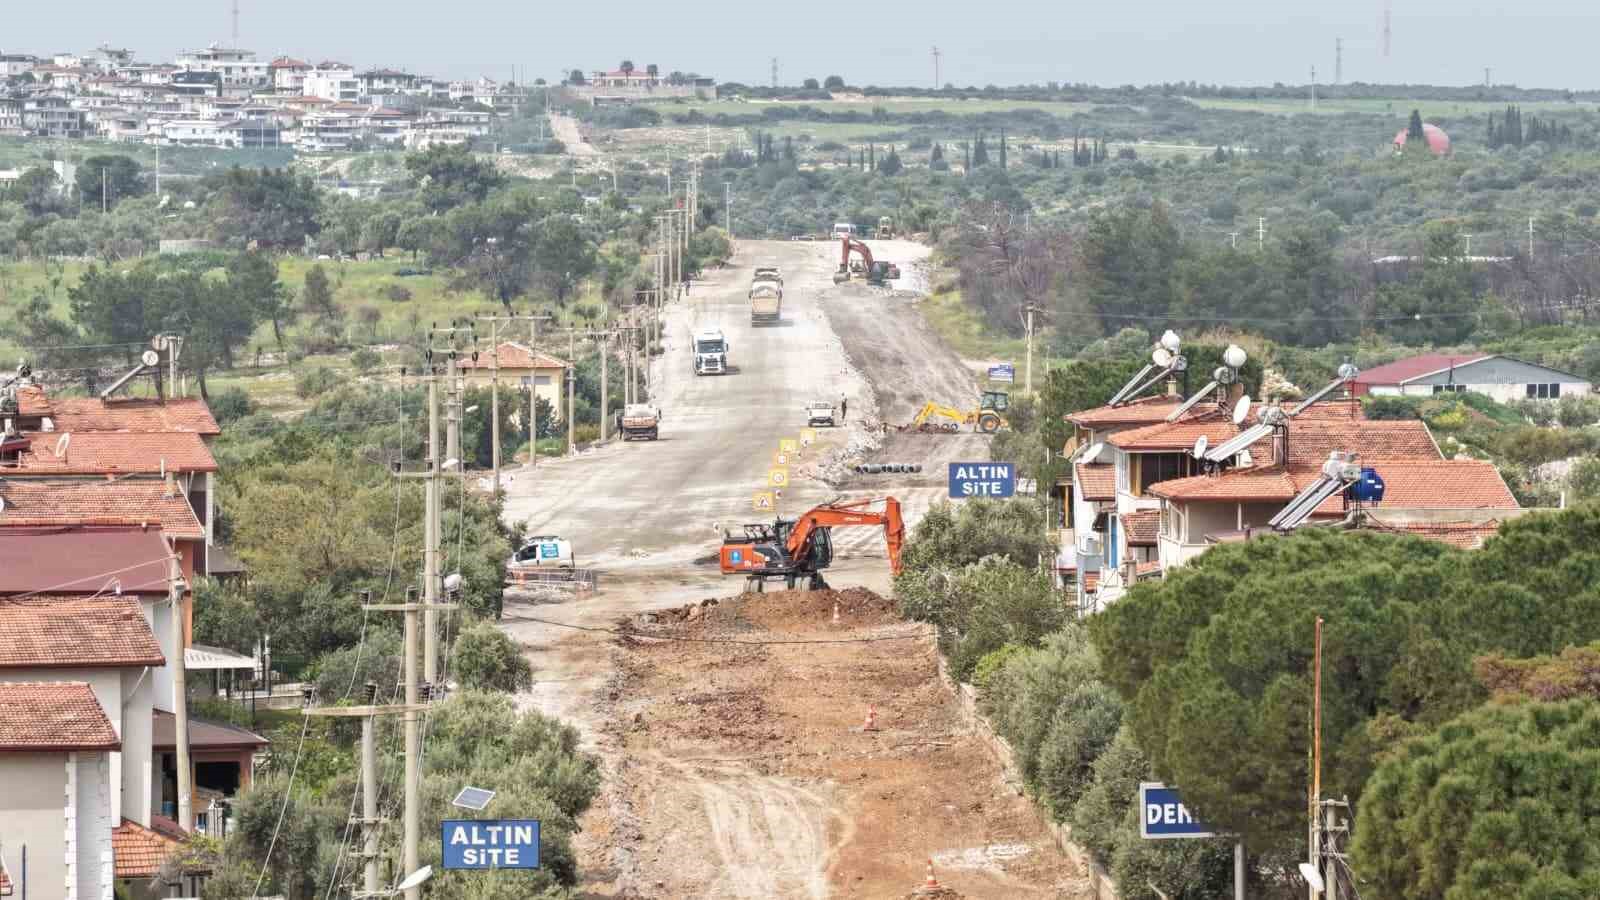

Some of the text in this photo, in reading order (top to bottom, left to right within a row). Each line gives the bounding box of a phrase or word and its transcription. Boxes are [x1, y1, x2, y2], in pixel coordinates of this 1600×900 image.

[956, 466, 1008, 479] ALTIN
[1147, 803, 1199, 825] DEN
[450, 826, 532, 845] ALTIN
